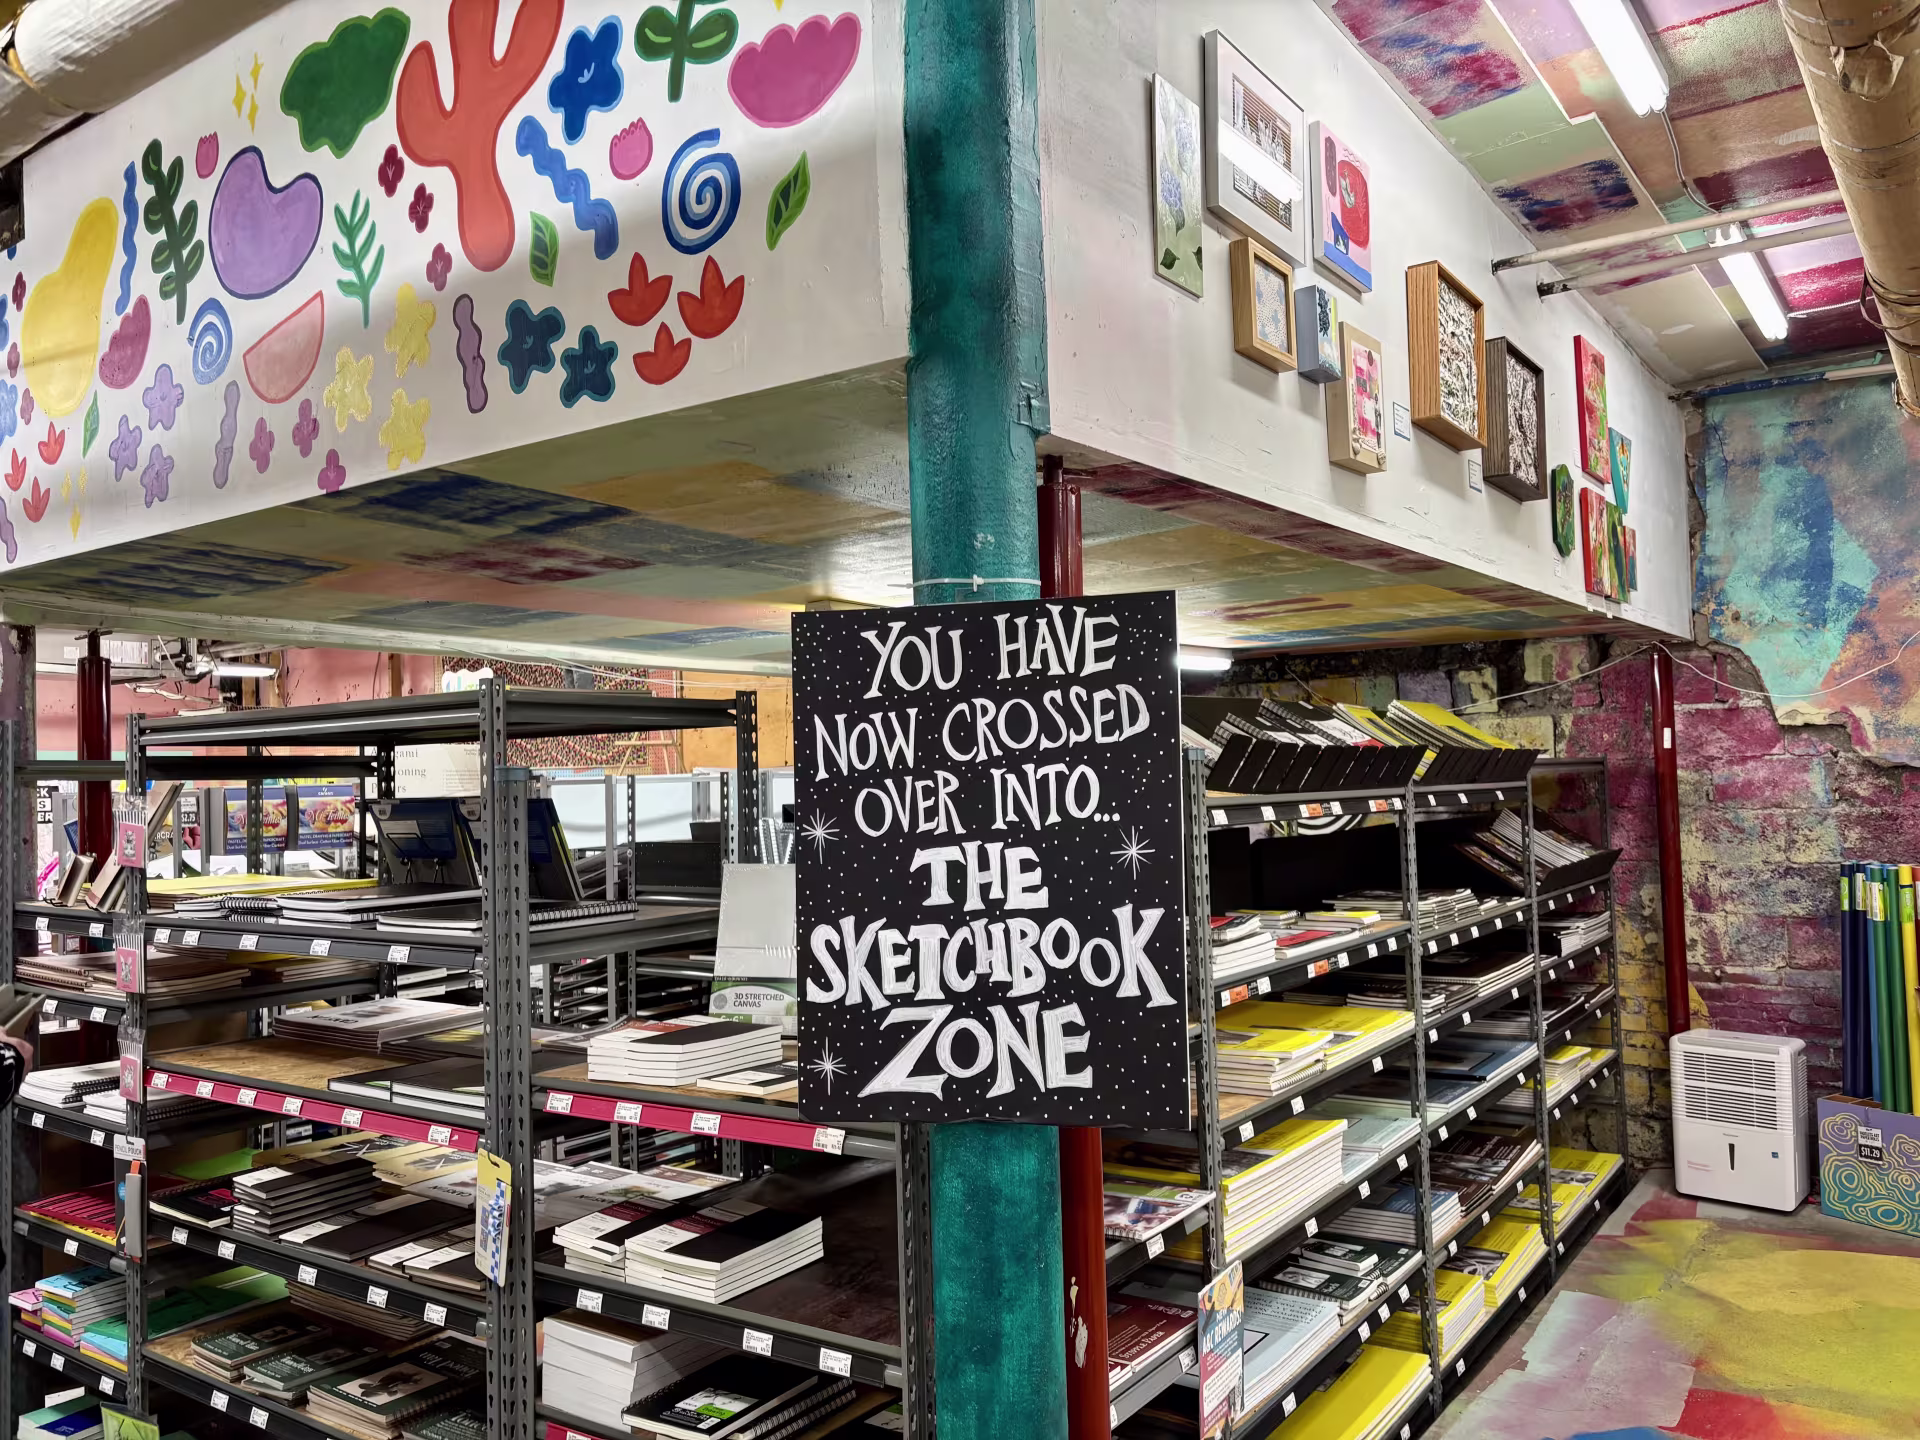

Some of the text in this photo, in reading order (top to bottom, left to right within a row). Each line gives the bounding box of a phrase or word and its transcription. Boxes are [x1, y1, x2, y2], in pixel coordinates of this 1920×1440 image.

[860, 603, 1120, 699] YOU HAVE
[814, 684, 1151, 782] NOW CROSSED
[854, 762, 1121, 837] OVER INTO...
[910, 841, 1049, 912] THE
[806, 903, 1178, 1011] SKETCHBOOK
[733, 992, 785, 1001] 3D STRETCHED
[733, 1000, 762, 1008] CANVAS
[857, 1001, 1093, 1101] ZONE
[115, 1144, 142, 1156] PENCIL POUCH
[1861, 1146, 1880, 1158] $11.29
